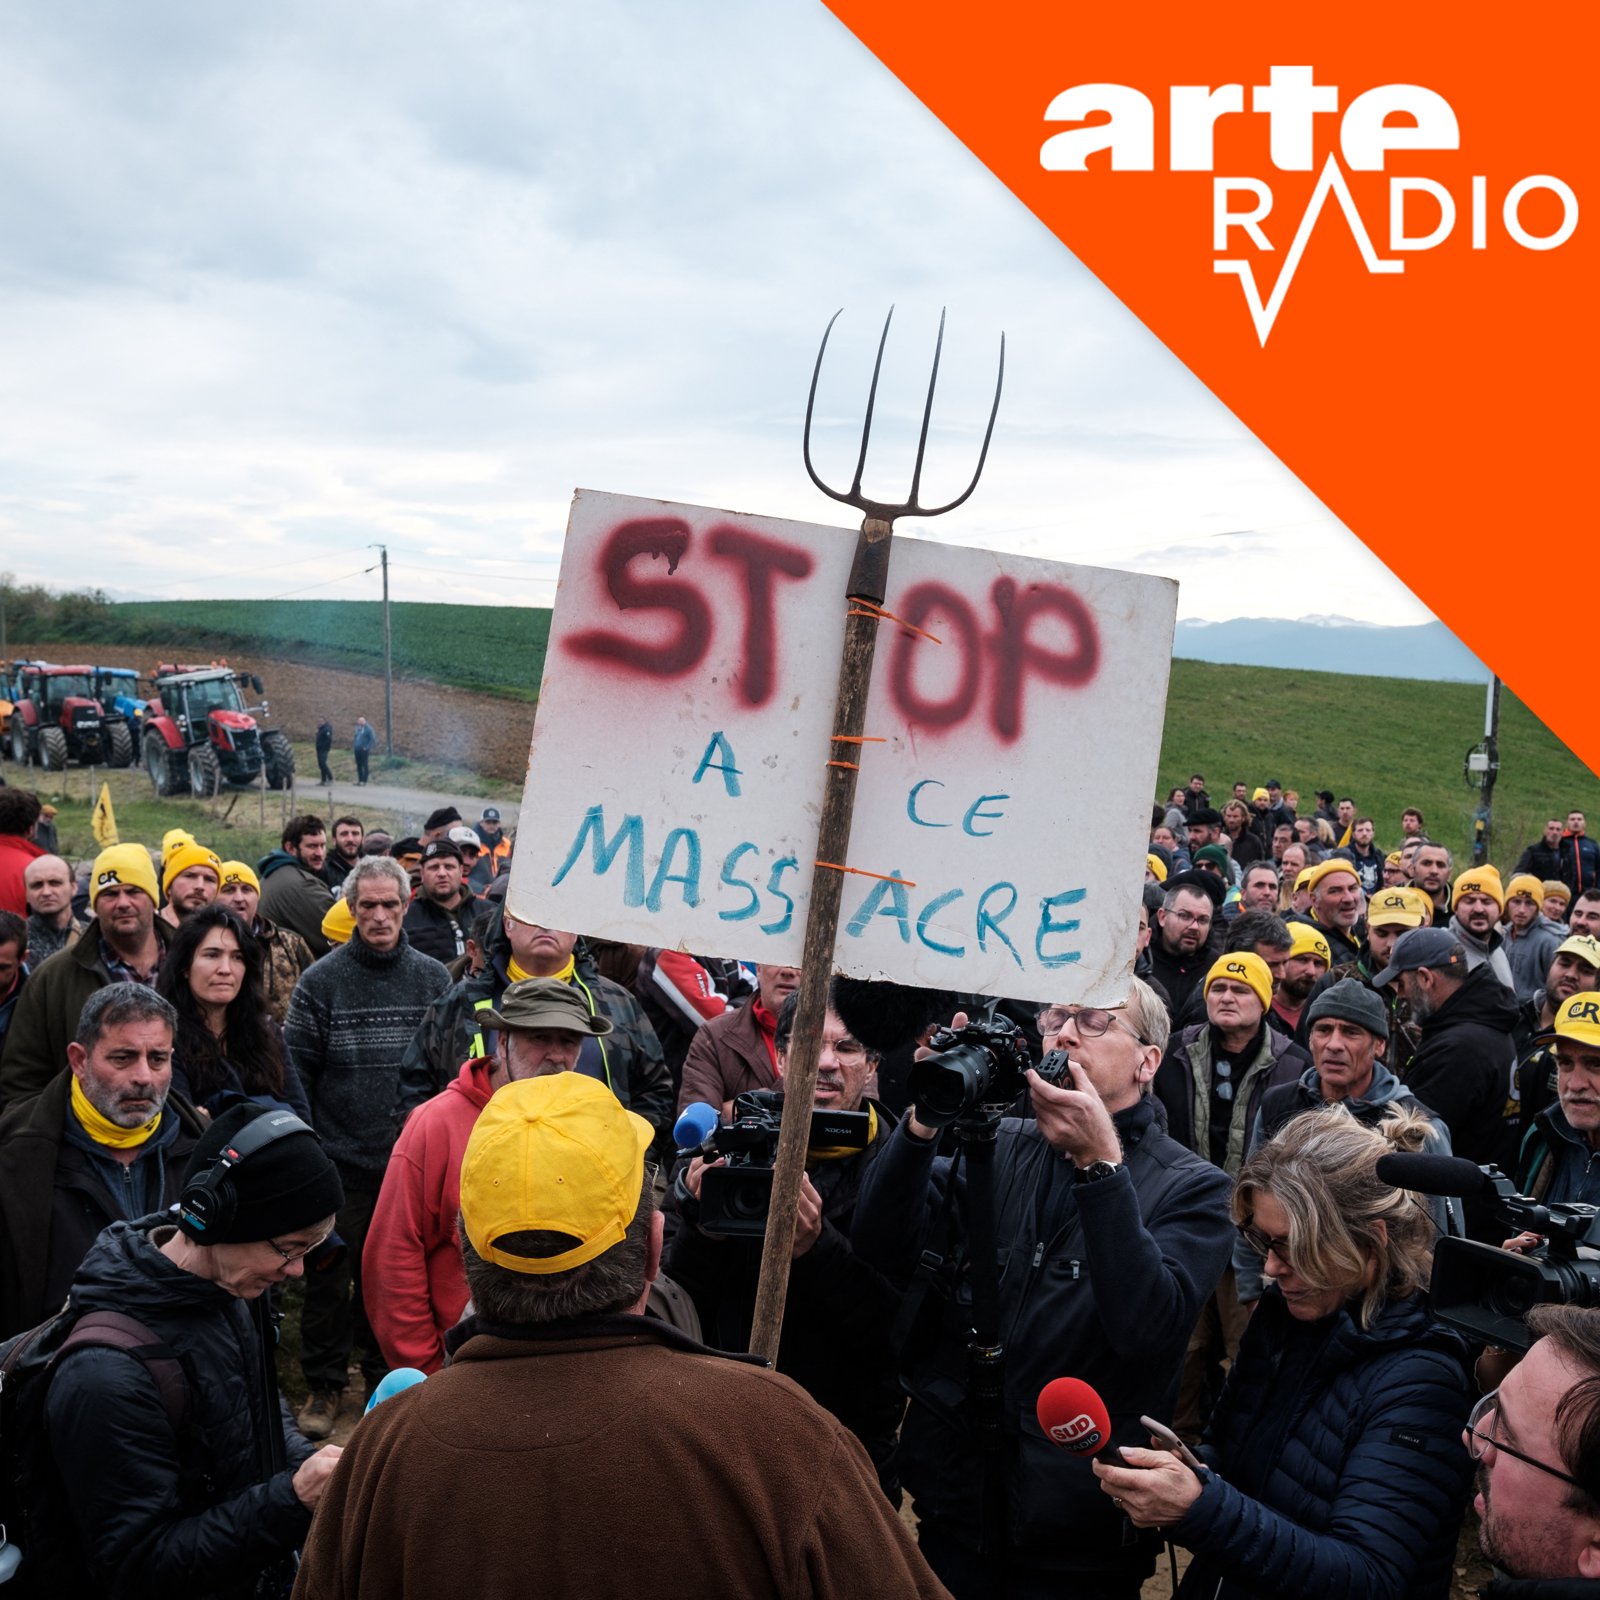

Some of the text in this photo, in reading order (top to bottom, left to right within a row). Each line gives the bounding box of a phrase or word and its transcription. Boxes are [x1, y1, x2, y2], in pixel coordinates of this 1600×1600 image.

[692, 731, 1011, 837] A CE
[97, 870, 122, 885] CR
[224, 873, 241, 883] CR
[1384, 896, 1406, 910] CR
[1226, 962, 1248, 979] CR
[1567, 1001, 1600, 1024] CR
[1053, 1417, 1090, 1440] SUD
